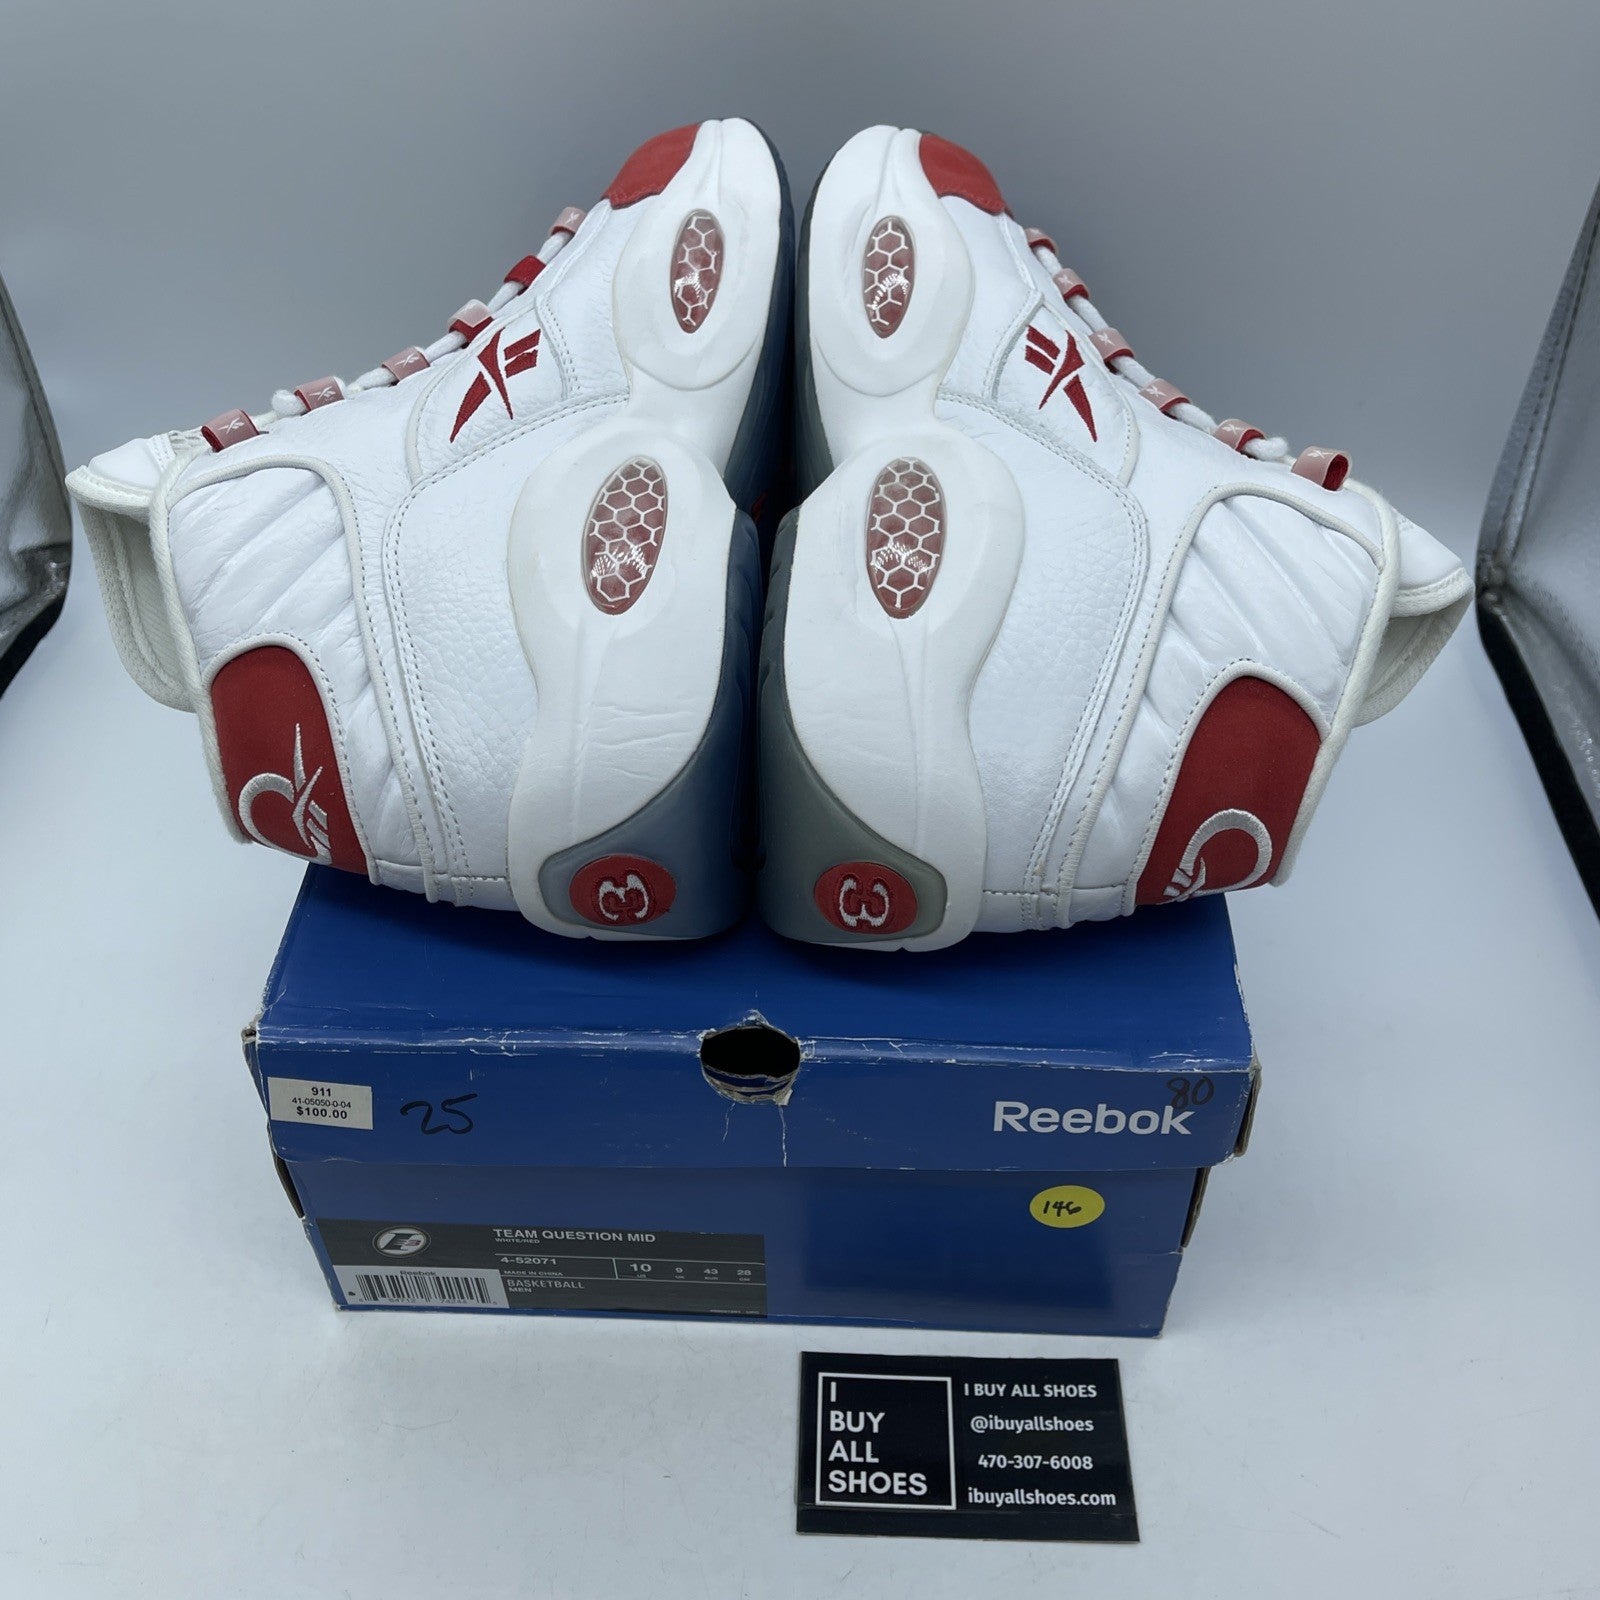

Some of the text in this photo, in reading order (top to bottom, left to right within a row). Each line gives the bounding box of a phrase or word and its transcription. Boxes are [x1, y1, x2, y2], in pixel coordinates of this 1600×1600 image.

[311, 1087, 331, 1097] 911
[1166, 1076, 1215, 1109] 80
[296, 1106, 348, 1119] $100.00
[400, 1093, 478, 1135] 25
[993, 1101, 1195, 1135] Reebok
[1042, 1201, 1082, 1217] 146
[493, 1229, 656, 1243] TEAM QUESTION MID
[500, 1256, 557, 1265] 4-52071
[629, 1263, 652, 1272] 10
[506, 1279, 585, 1289] BASKETBALL
[830, 1381, 837, 1402] I
[964, 1383, 1097, 1398] I BUY ALL SHOES
[829, 1410, 885, 1434] BUY
[970, 1415, 1094, 1433] @ibuyallshoes
[828, 1440, 879, 1464] ALL
[977, 1454, 1093, 1470] 470-307-6008
[828, 1470, 928, 1496] SHOES
[967, 1487, 1116, 1507] ibuyallshoes.com
